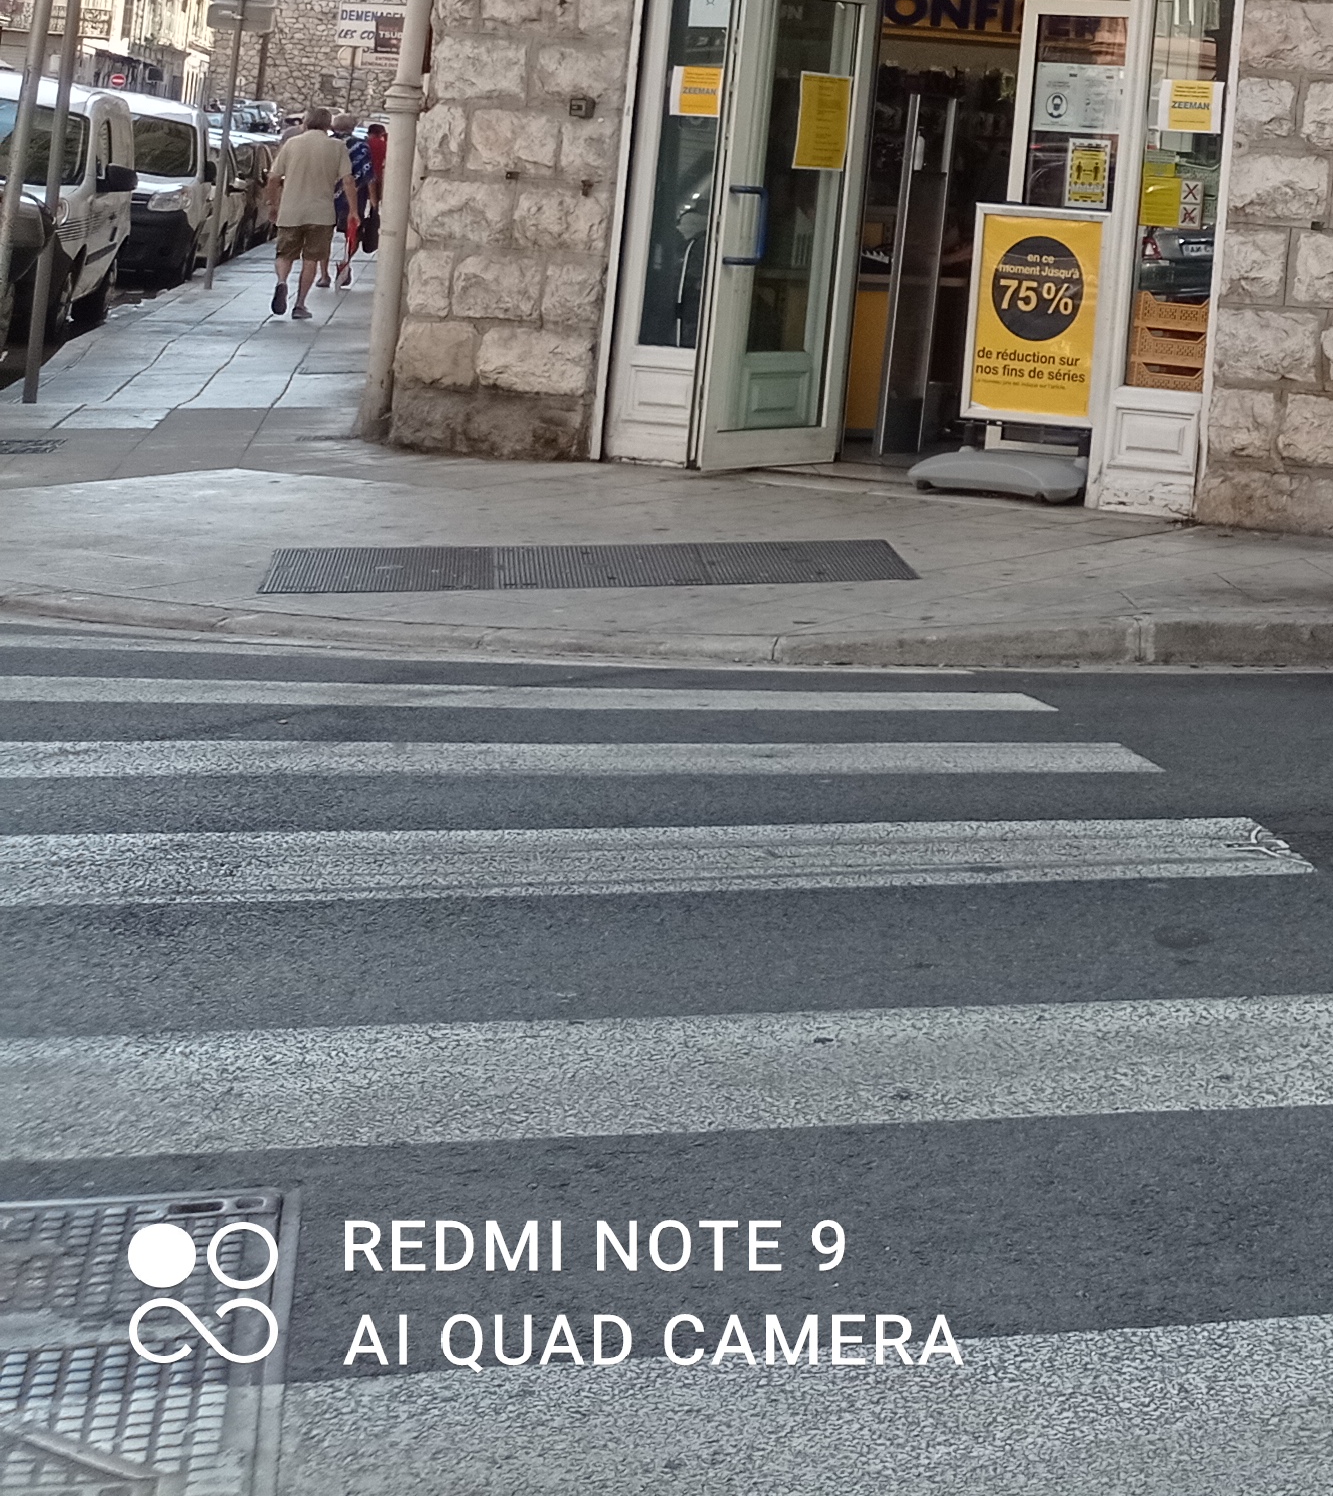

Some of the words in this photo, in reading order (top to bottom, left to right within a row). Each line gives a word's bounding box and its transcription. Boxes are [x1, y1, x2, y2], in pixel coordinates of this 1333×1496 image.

[682, 86, 717, 96] ZEEMAN
[1171, 100, 1210, 111] ZEEMAN
[1027, 254, 1041, 262] en
[1041, 255, 1055, 264] ce
[998, 263, 1040, 276] moment
[977, 347, 993, 359] de
[996, 348, 1056, 365] réduction
[1059, 356, 1081, 367] sur
[975, 364, 999, 375] nos
[1002, 364, 1025, 378] fins
[1028, 367, 1044, 380] de
[1047, 369, 1086, 383] séries
